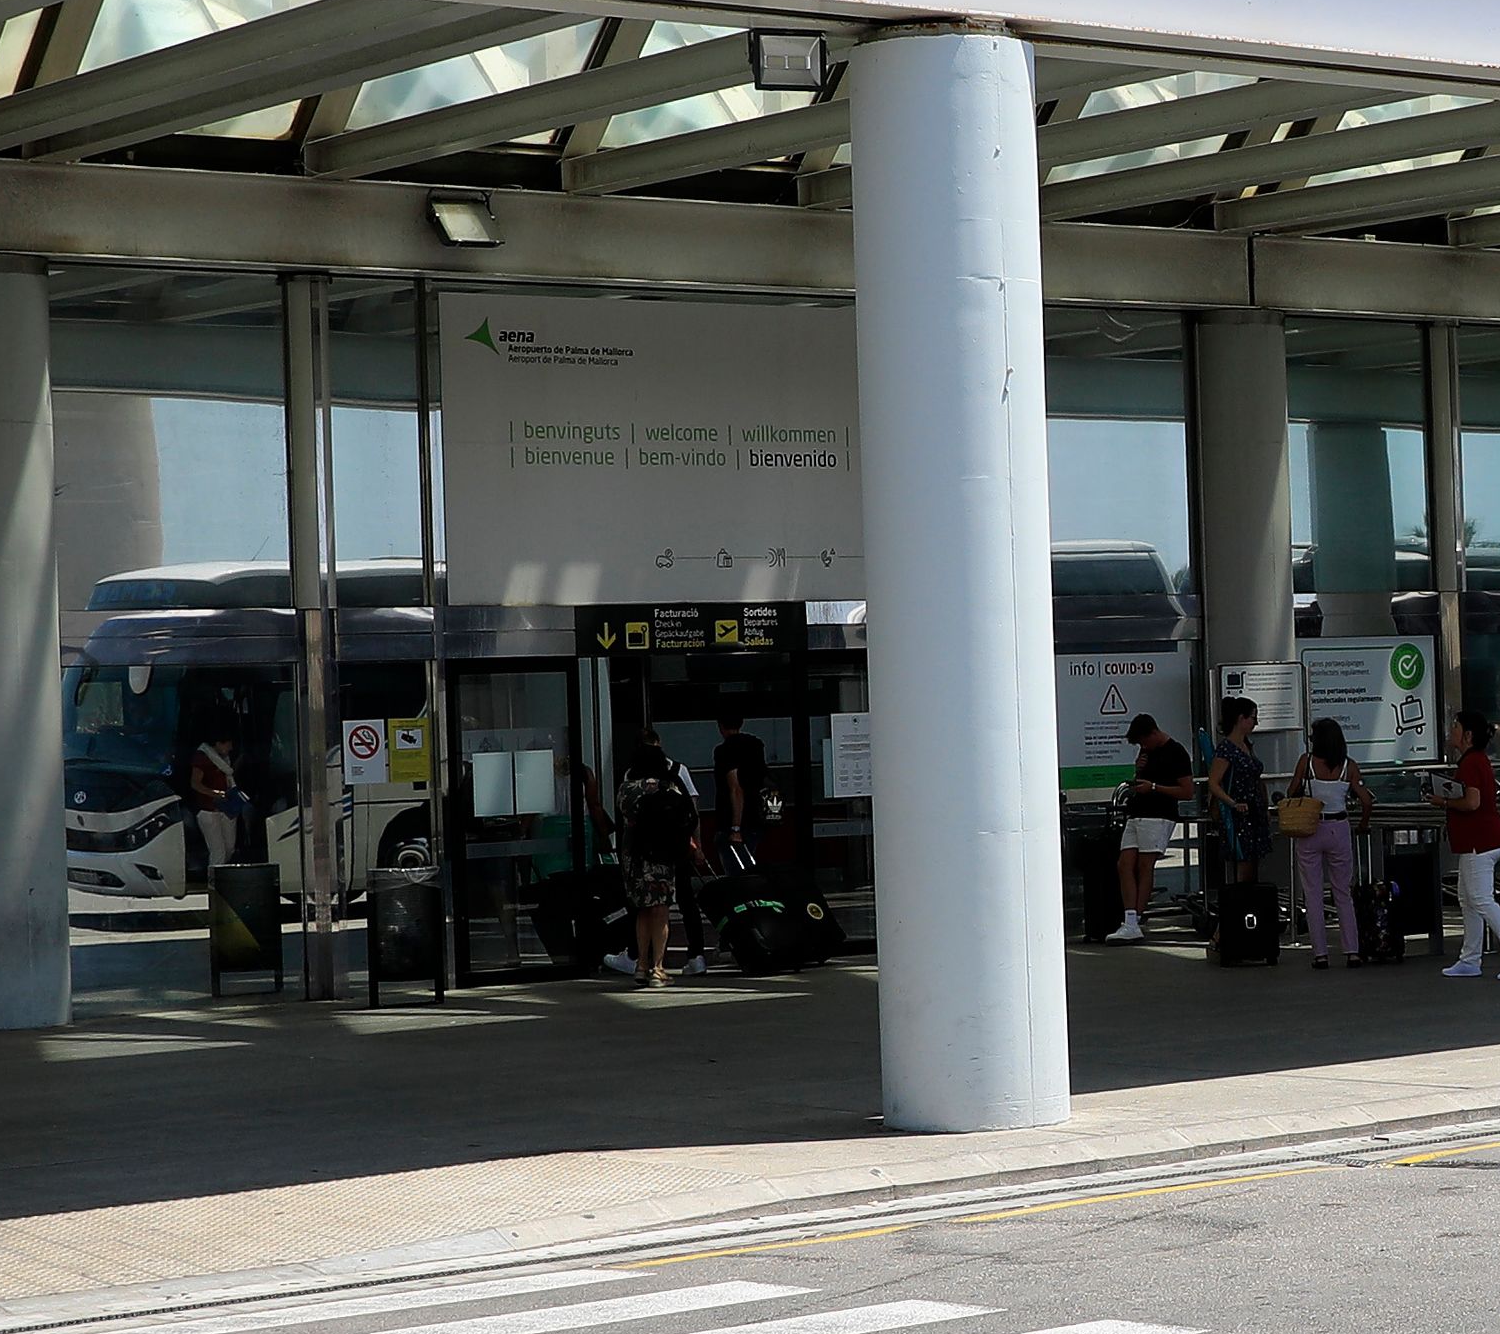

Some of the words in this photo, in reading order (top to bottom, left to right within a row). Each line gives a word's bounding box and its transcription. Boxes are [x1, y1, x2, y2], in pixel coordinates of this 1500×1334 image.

[499, 330, 535, 343] aena
[508, 344, 552, 355] Aeropuerto
[554, 345, 564, 355] de
[565, 346, 589, 356] Palma
[590, 347, 600, 356] de
[602, 347, 634, 357] Mallorca
[508, 354, 541, 364] Aeroport
[542, 355, 552, 364] de
[553, 356, 576, 365] Palma
[577, 356, 587, 365] de
[589, 356, 619, 366] Mallorca
[524, 421, 621, 444] benvinguts
[645, 424, 718, 442] welcome
[742, 425, 837, 444] willkommen
[525, 446, 615, 466] bienvenue
[639, 447, 727, 468] bem-vindo
[749, 449, 837, 468] bienvenido
[654, 608, 699, 618] Facturació
[743, 607, 778, 618] Sortides
[744, 618, 779, 627] Departures
[744, 627, 764, 637] Abflug
[656, 638, 706, 649] Facturación
[744, 637, 774, 647] Salidas
[1069, 661, 1096, 677] info
[1104, 661, 1155, 676] COVID-19
